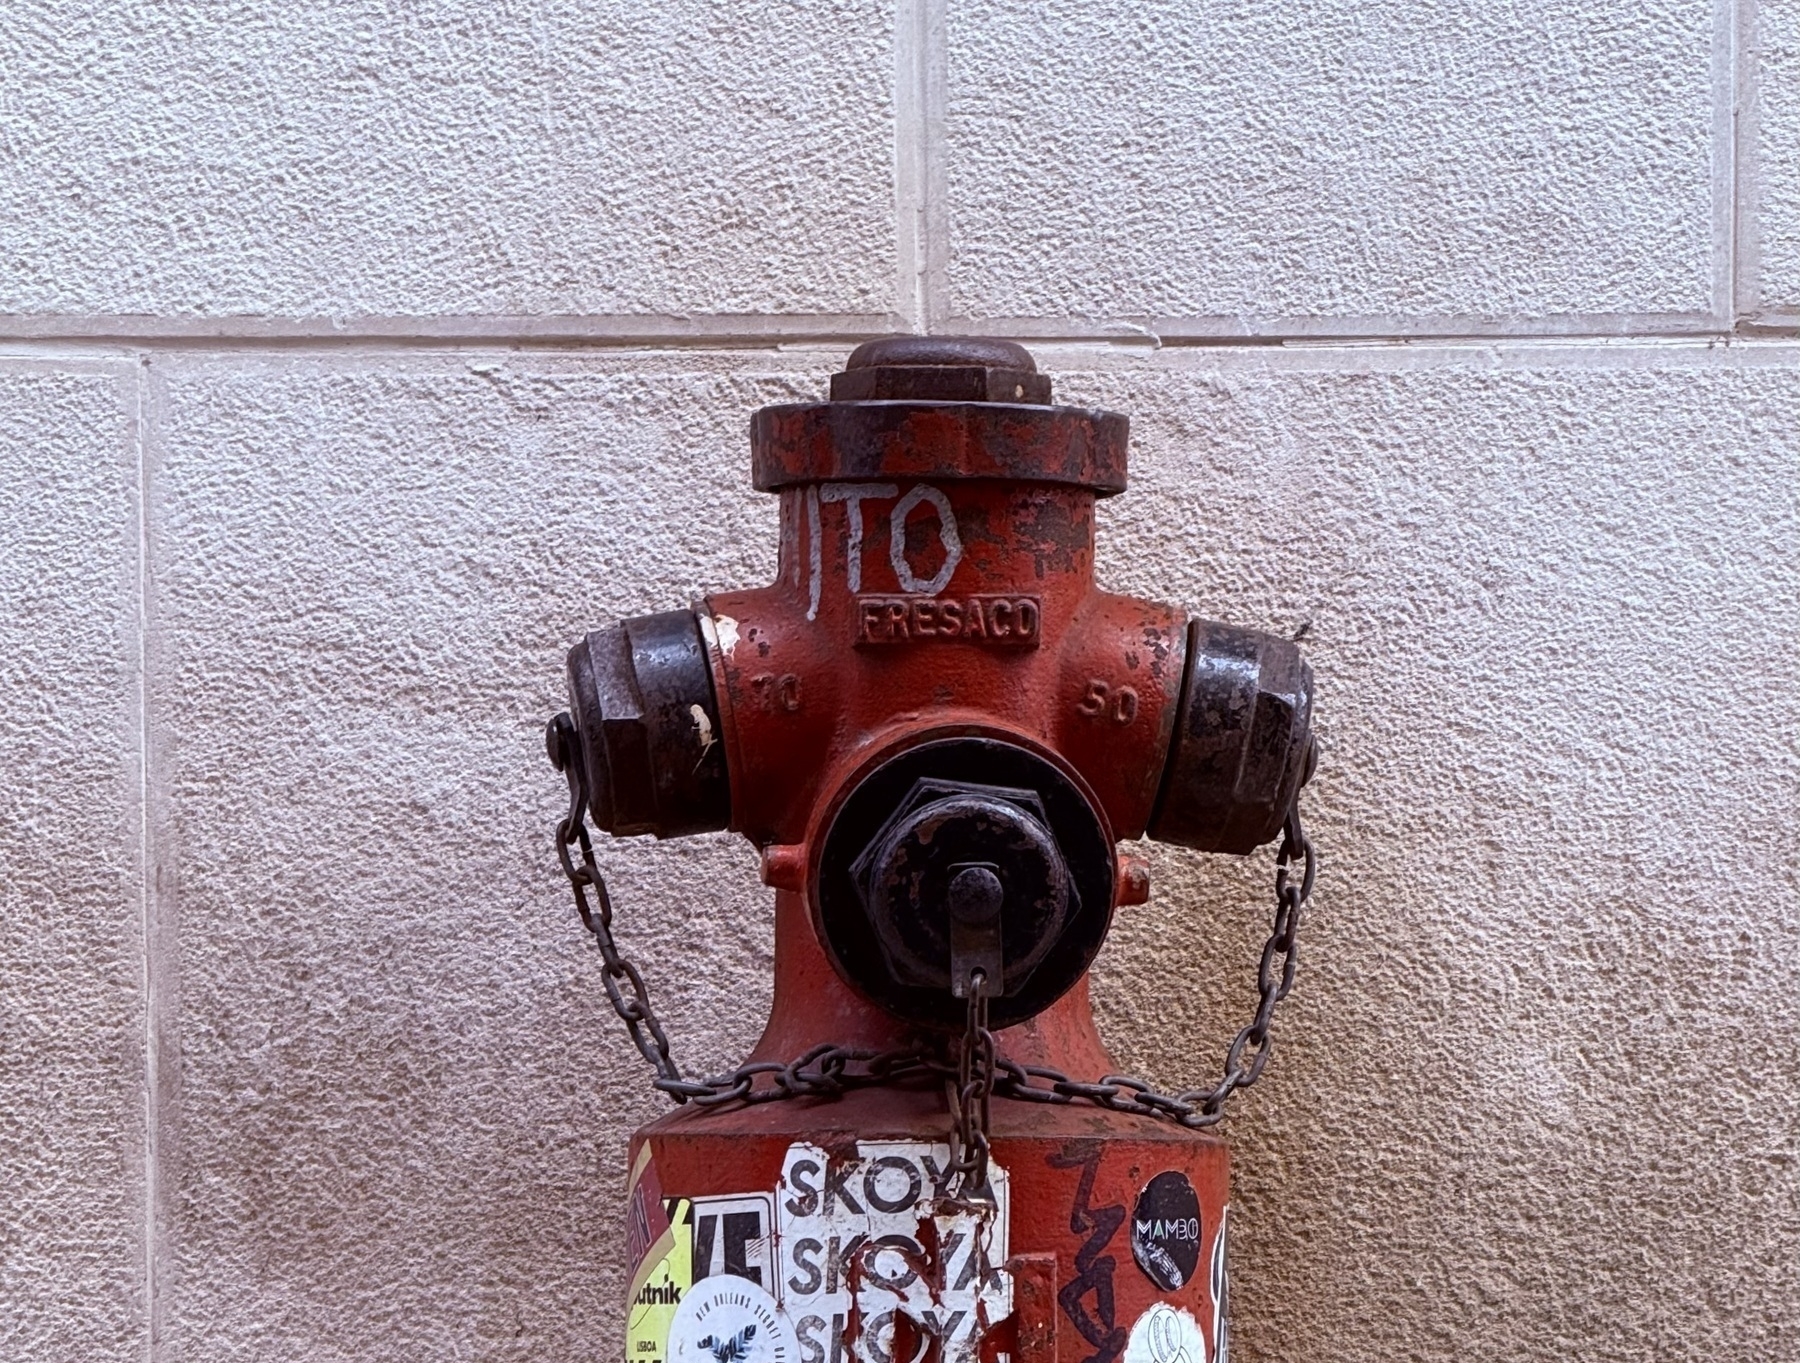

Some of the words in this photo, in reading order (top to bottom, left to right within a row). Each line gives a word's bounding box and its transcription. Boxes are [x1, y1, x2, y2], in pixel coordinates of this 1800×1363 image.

[859, 599, 1040, 641] FRESACO
[1077, 679, 1139, 727] 50
[1136, 1218, 1199, 1240] MAMBO
[754, 1304, 782, 1340] SECRET
[637, 1340, 657, 1353] LISBOA
